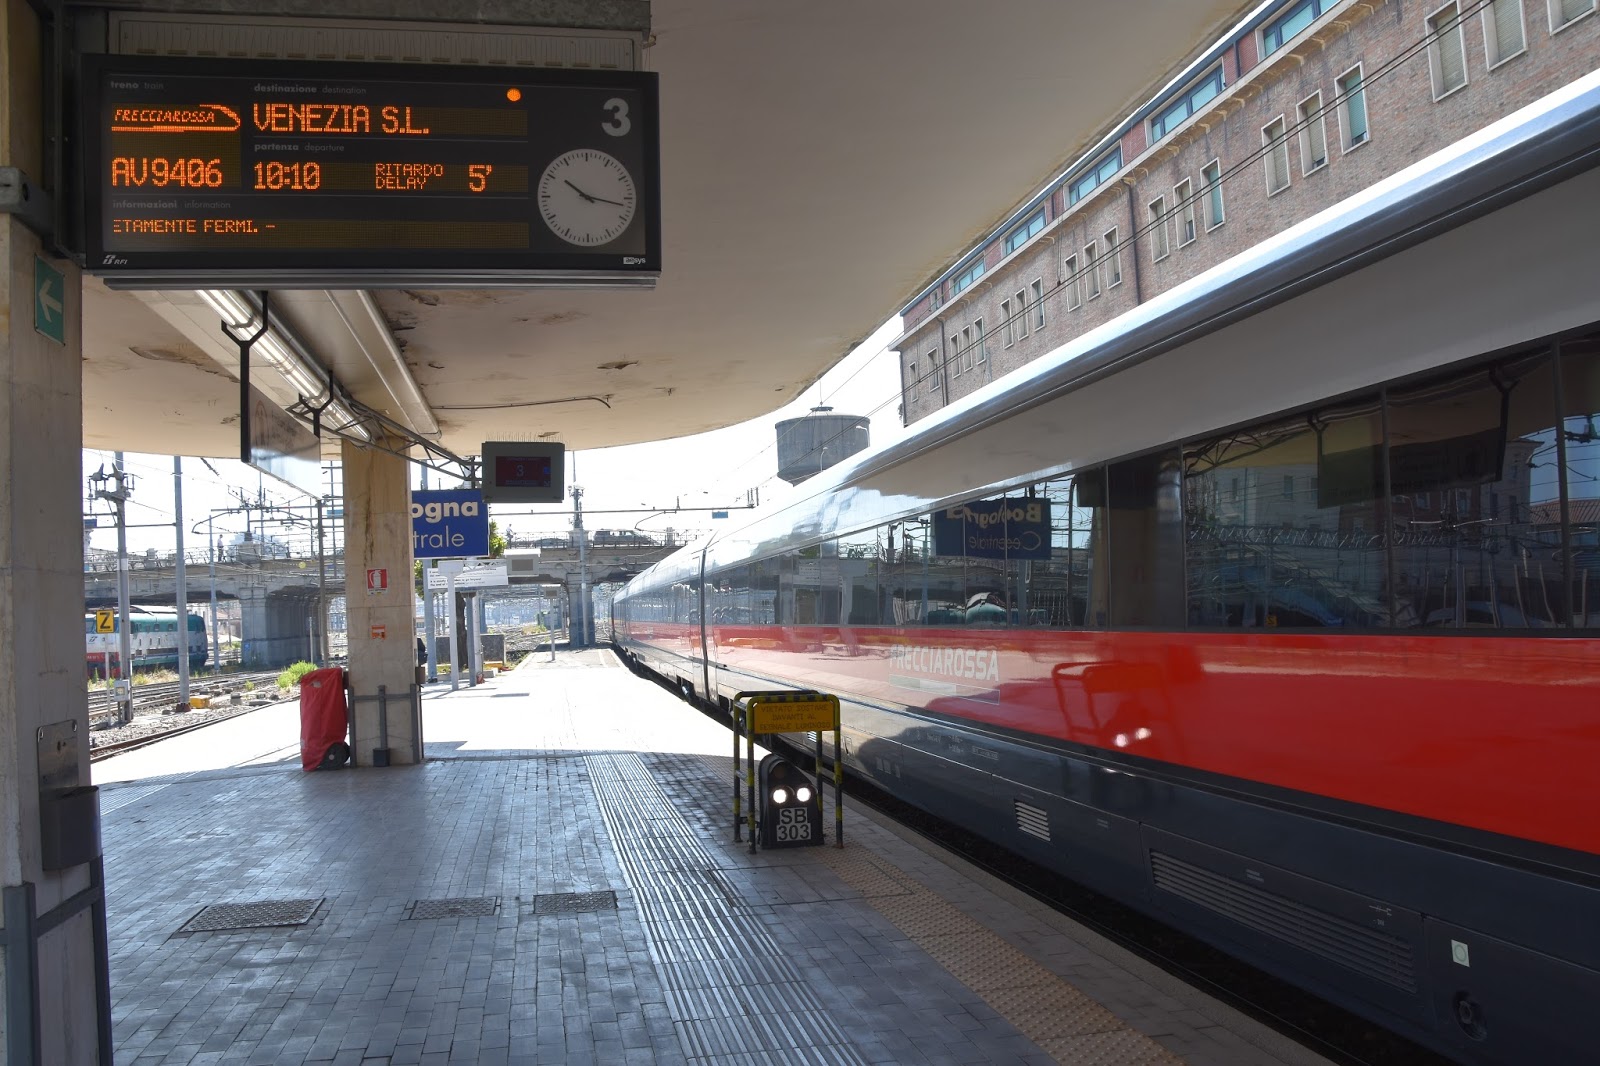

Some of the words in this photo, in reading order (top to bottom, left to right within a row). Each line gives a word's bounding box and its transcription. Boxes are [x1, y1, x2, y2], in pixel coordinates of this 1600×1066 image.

[110, 81, 139, 89] treno
[144, 81, 164, 89] train
[254, 83, 317, 93] destinazione
[322, 85, 367, 94] destination
[114, 109, 215, 123] FRECCIAROSSA
[253, 103, 370, 133] VENEZIA
[381, 106, 430, 134] S.L.
[602, 97, 631, 137] 3
[254, 143, 299, 152] partenza
[304, 143, 345, 153] departure
[254, 162, 321, 190] 10:10
[375, 163, 444, 177] RITARDO
[468, 164, 493, 192] 5'
[375, 176, 427, 190] DELAY
[113, 200, 177, 209] informazioni
[184, 200, 231, 209] information
[203, 219, 259, 234] FERMI.
[412, 501, 478, 524] ogna
[413, 525, 465, 549] trale
[99, 612, 111, 629] Z
[780, 808, 807, 824] SB
[777, 824, 810, 841] 303
